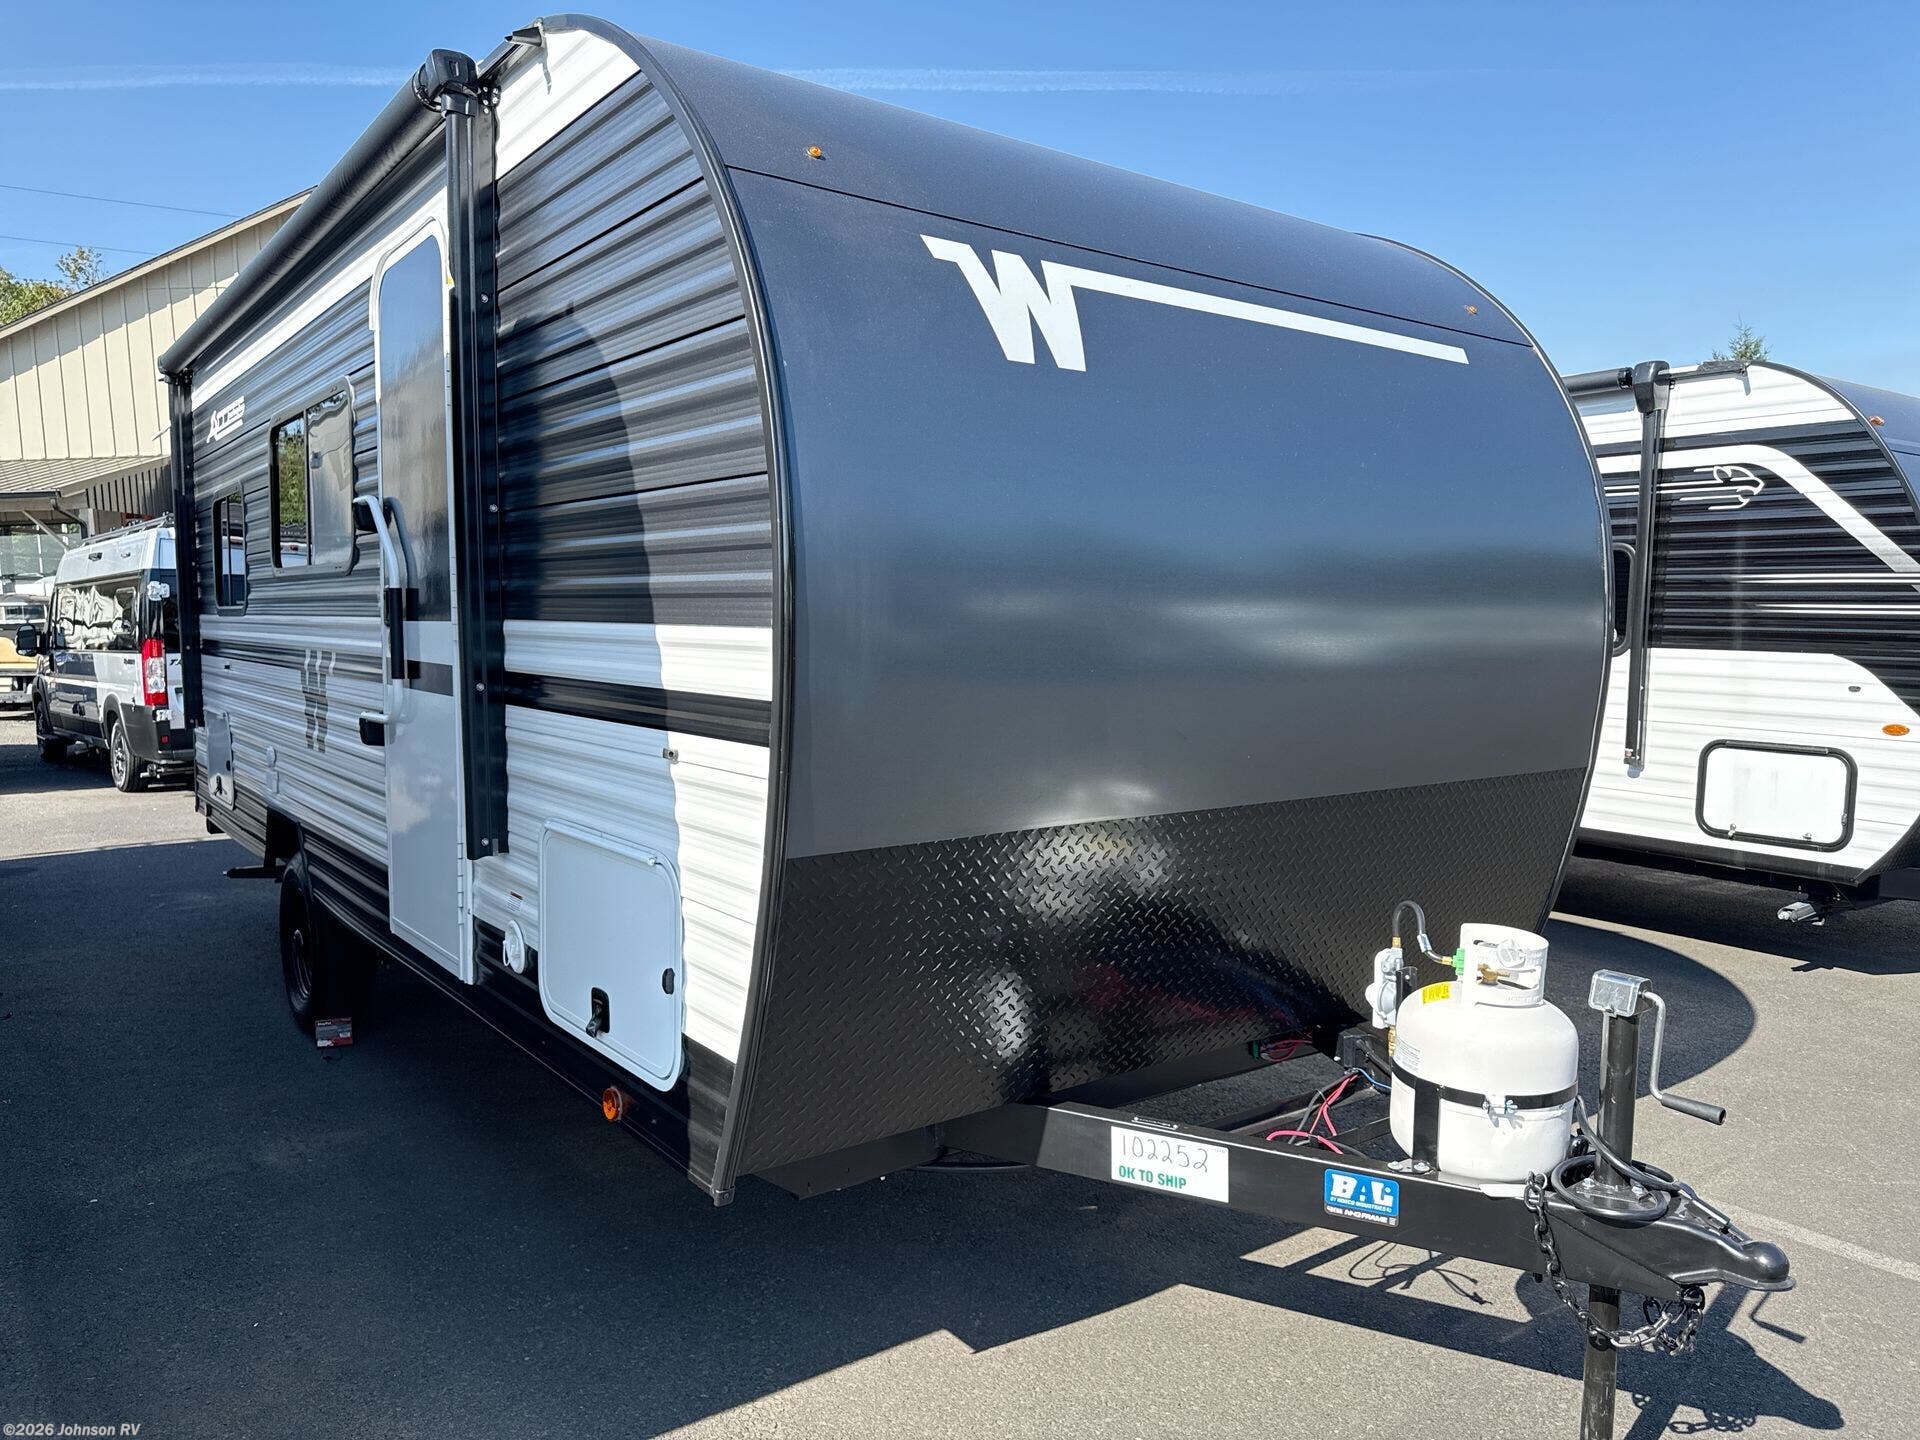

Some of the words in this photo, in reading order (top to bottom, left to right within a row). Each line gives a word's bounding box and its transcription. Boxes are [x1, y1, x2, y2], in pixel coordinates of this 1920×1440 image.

[1123, 1135, 1208, 1173] 102252
[1119, 1165, 1136, 1179] OK
[1139, 1169, 1153, 1183] TO
[1158, 1173, 1187, 1189] SHIP
[1331, 1173, 1394, 1207] BAL
